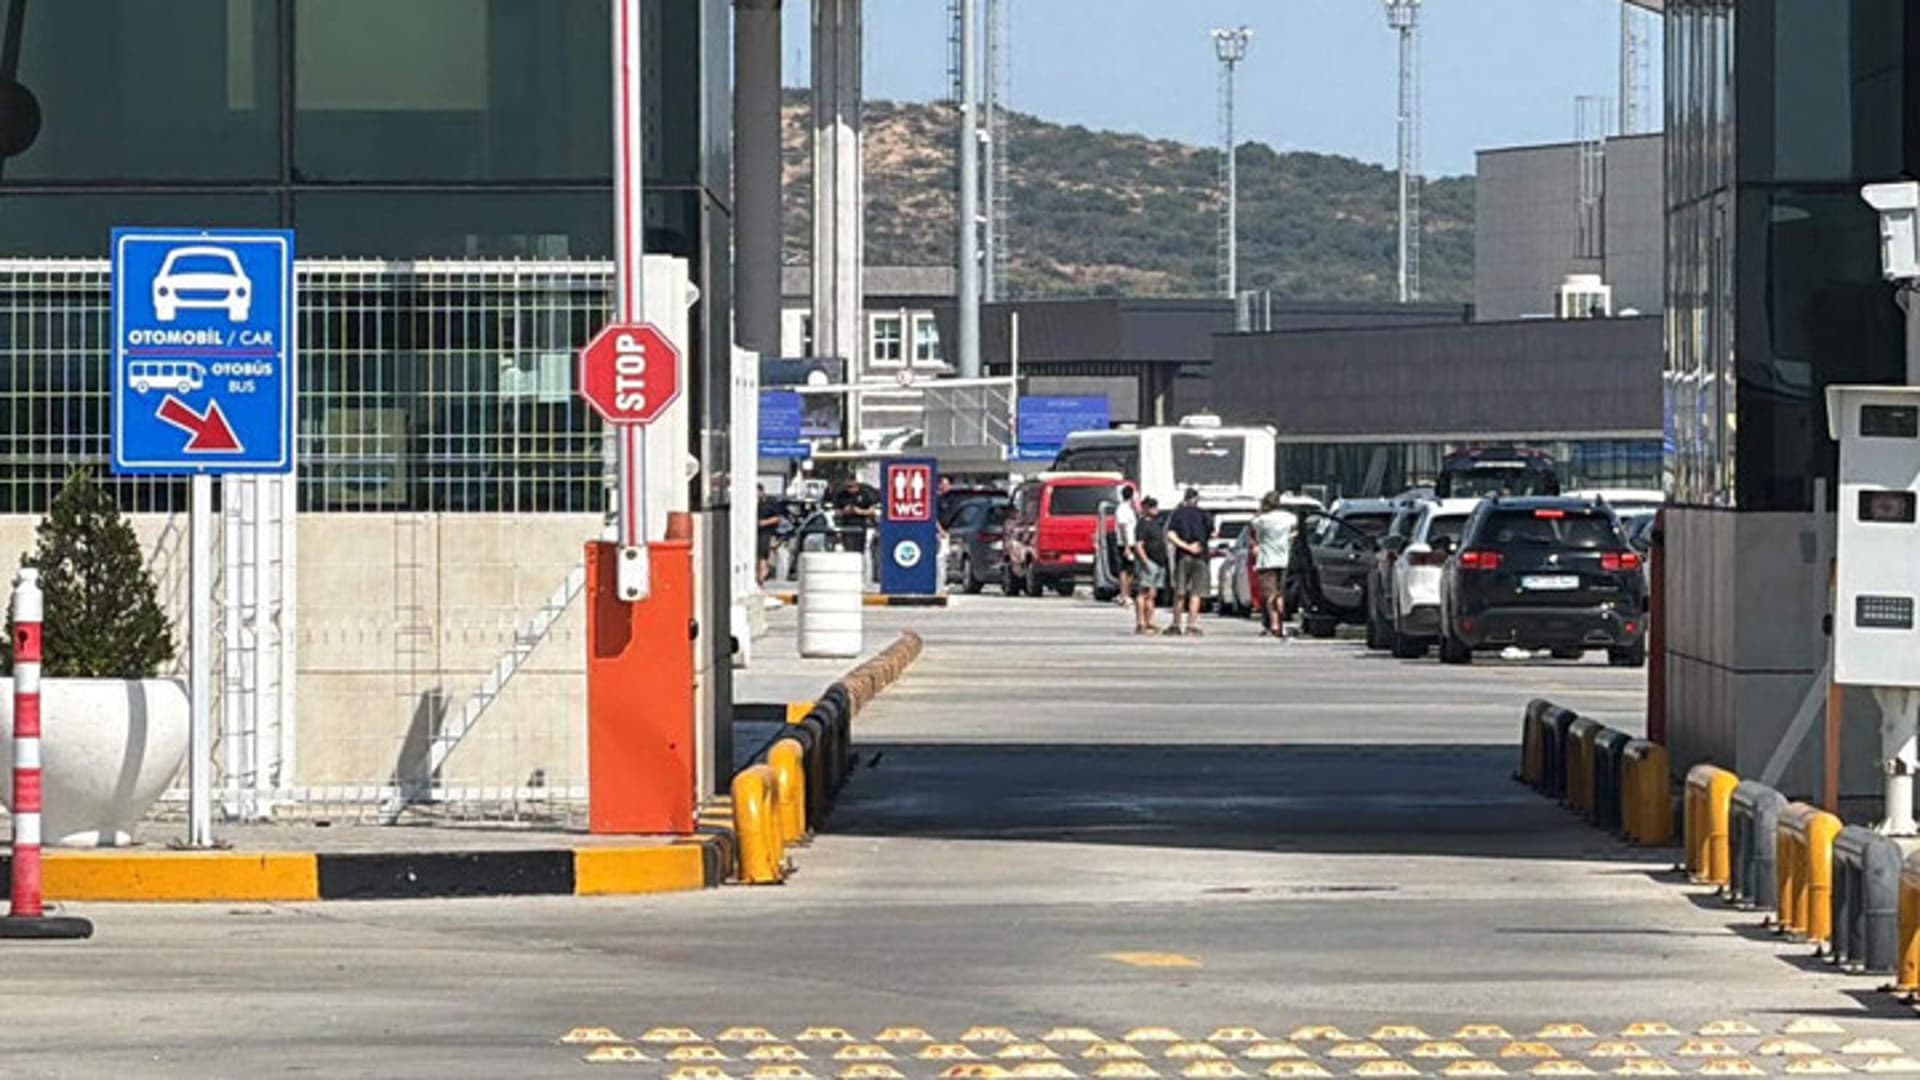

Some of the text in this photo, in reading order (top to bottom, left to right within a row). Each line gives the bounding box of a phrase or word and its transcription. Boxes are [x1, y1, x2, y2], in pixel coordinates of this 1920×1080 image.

[129, 328, 273, 346] OTOMOBİL / CAR
[211, 360, 273, 376] OTOBÜS
[615, 334, 646, 411] STOP
[228, 380, 255, 393] BUS
[895, 503, 924, 516] WC
